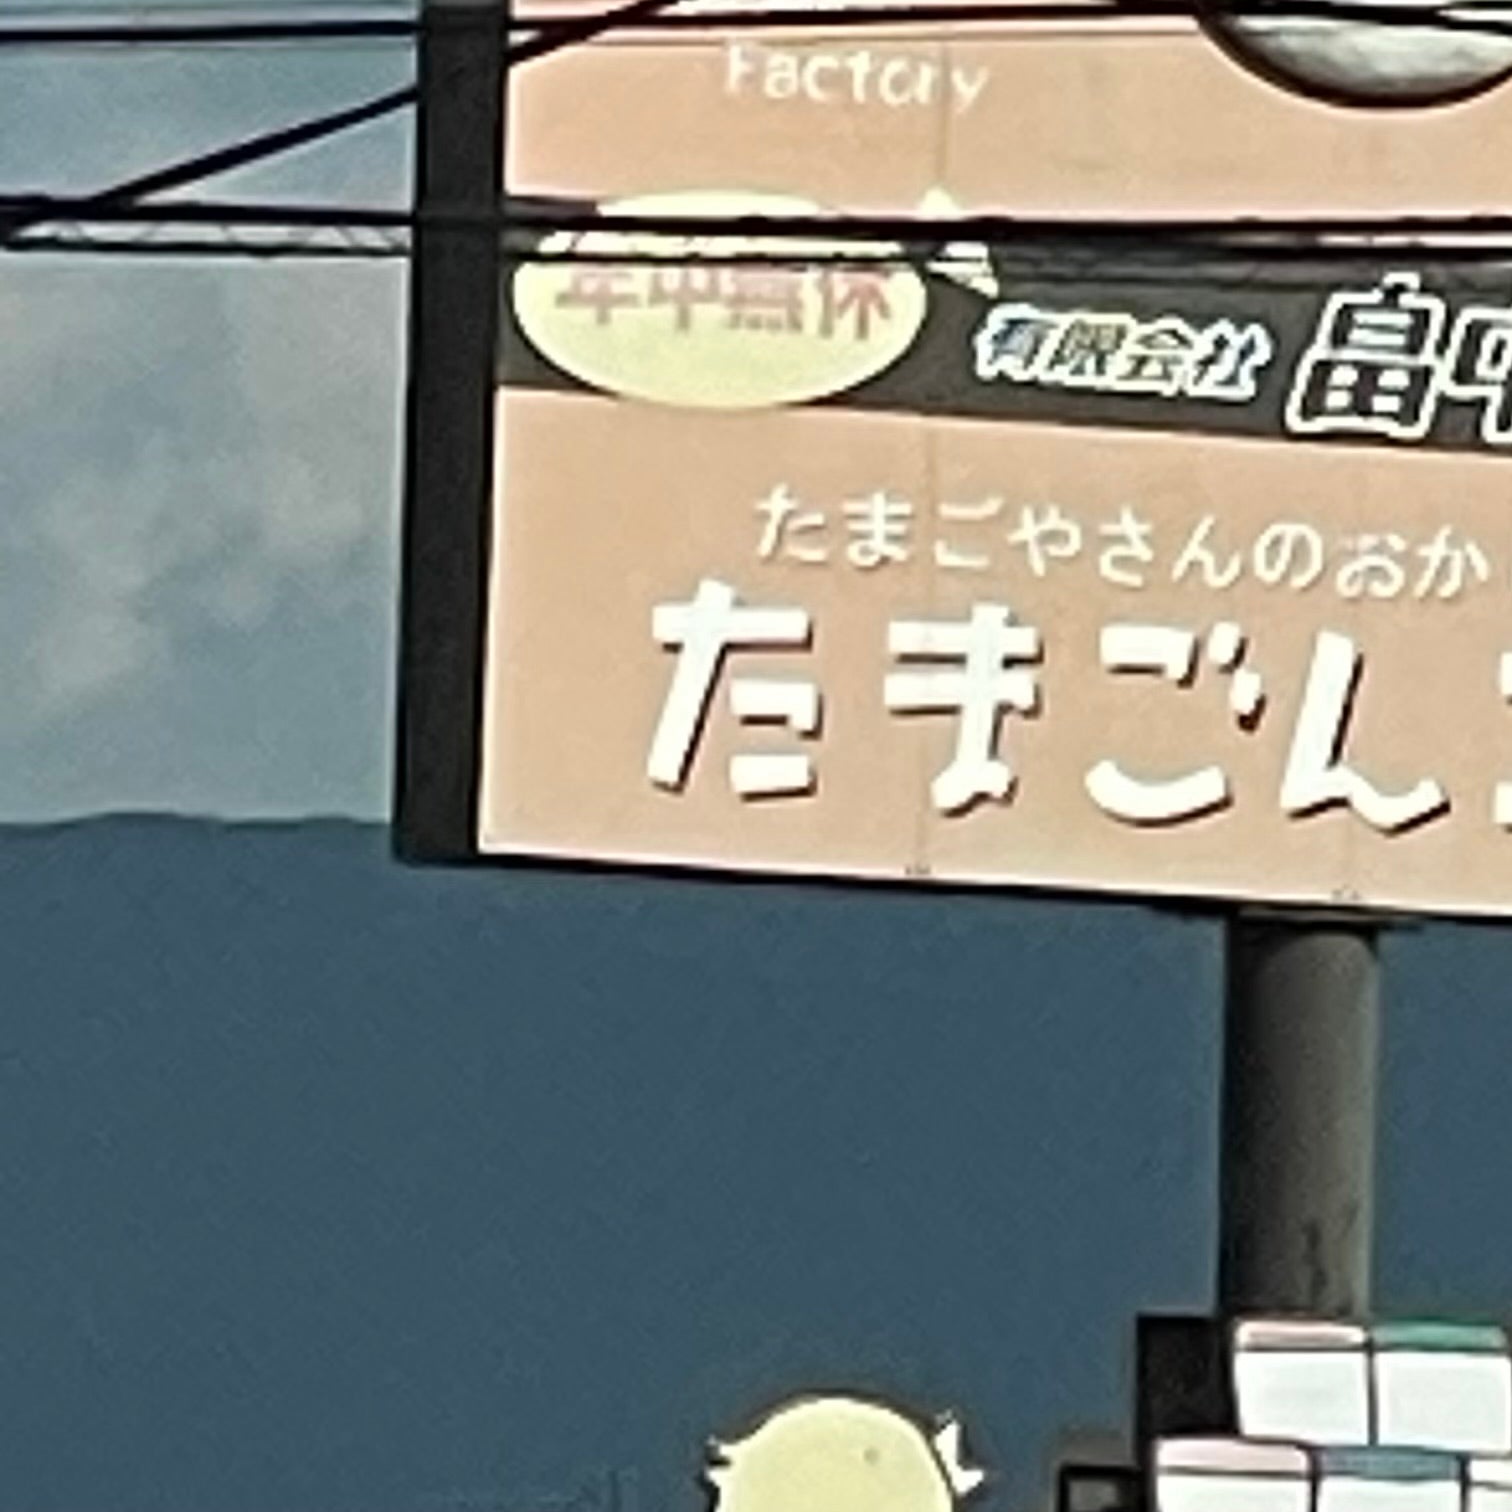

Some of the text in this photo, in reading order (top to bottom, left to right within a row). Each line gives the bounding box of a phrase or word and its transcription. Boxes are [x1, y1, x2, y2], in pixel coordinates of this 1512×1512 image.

[727, 40, 988, 110] Factory
[974, 303, 1273, 401] 有限会社
